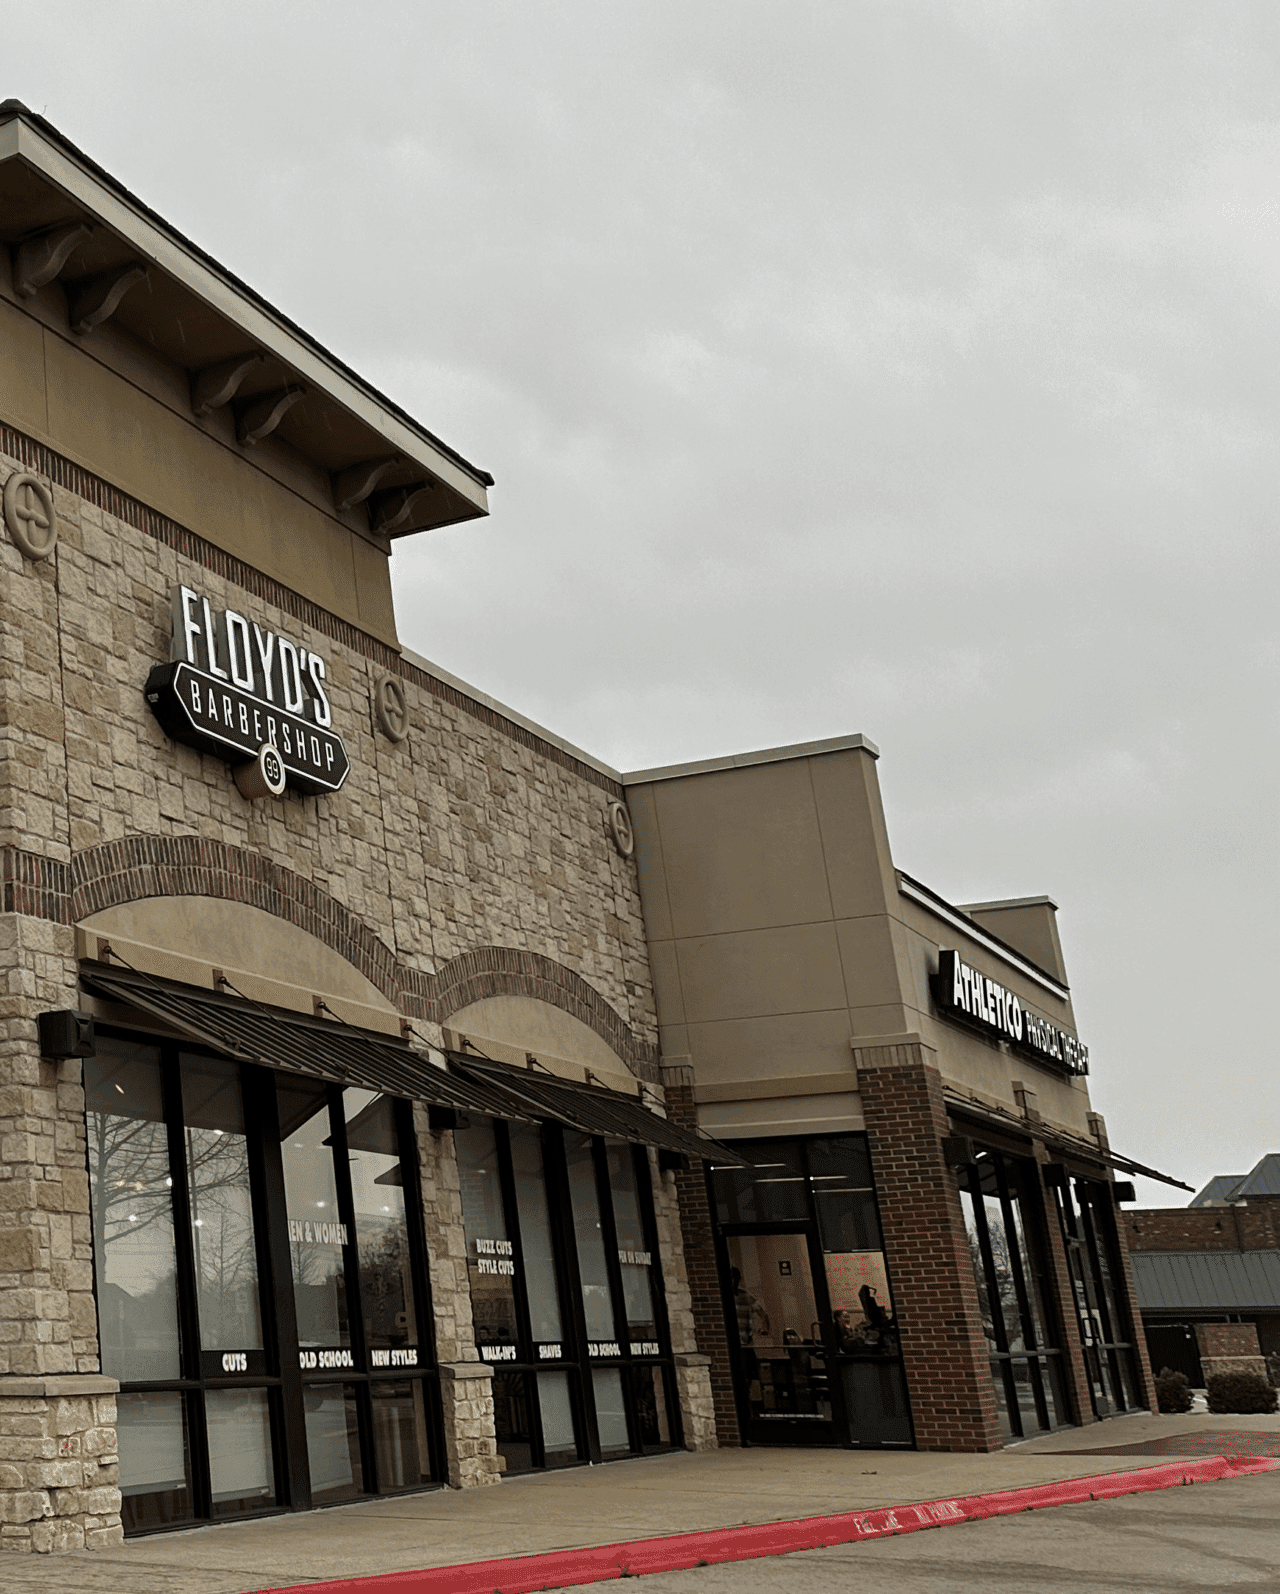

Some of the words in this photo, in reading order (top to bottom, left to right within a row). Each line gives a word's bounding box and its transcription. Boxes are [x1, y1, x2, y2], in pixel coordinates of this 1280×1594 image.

[180, 584, 332, 729] FLOYD'S
[190, 679, 335, 772] BARBERSHOP
[266, 757, 279, 779] 99
[954, 950, 1022, 1041] ATHLETICO
[1025, 1010, 1062, 1061] PHYSICAL
[305, 1220, 313, 1243] &
[313, 1221, 349, 1246] WOMEN
[476, 1238, 496, 1255] BUZZ
[496, 1240, 513, 1256] CUTS
[477, 1258, 497, 1275] STYLE
[498, 1260, 515, 1276] CUTS
[481, 1345, 517, 1361] WALK-IN'S
[538, 1344, 562, 1359] SHAVES
[599, 1343, 621, 1357] SCHOOL
[629, 1342, 642, 1355] NEW
[642, 1342, 660, 1355] STYLES
[222, 1352, 248, 1372] CUTS
[299, 1351, 317, 1369] OLD
[318, 1350, 354, 1369] SCHOOL
[371, 1350, 390, 1367] NEW
[391, 1349, 419, 1366] STYLES
